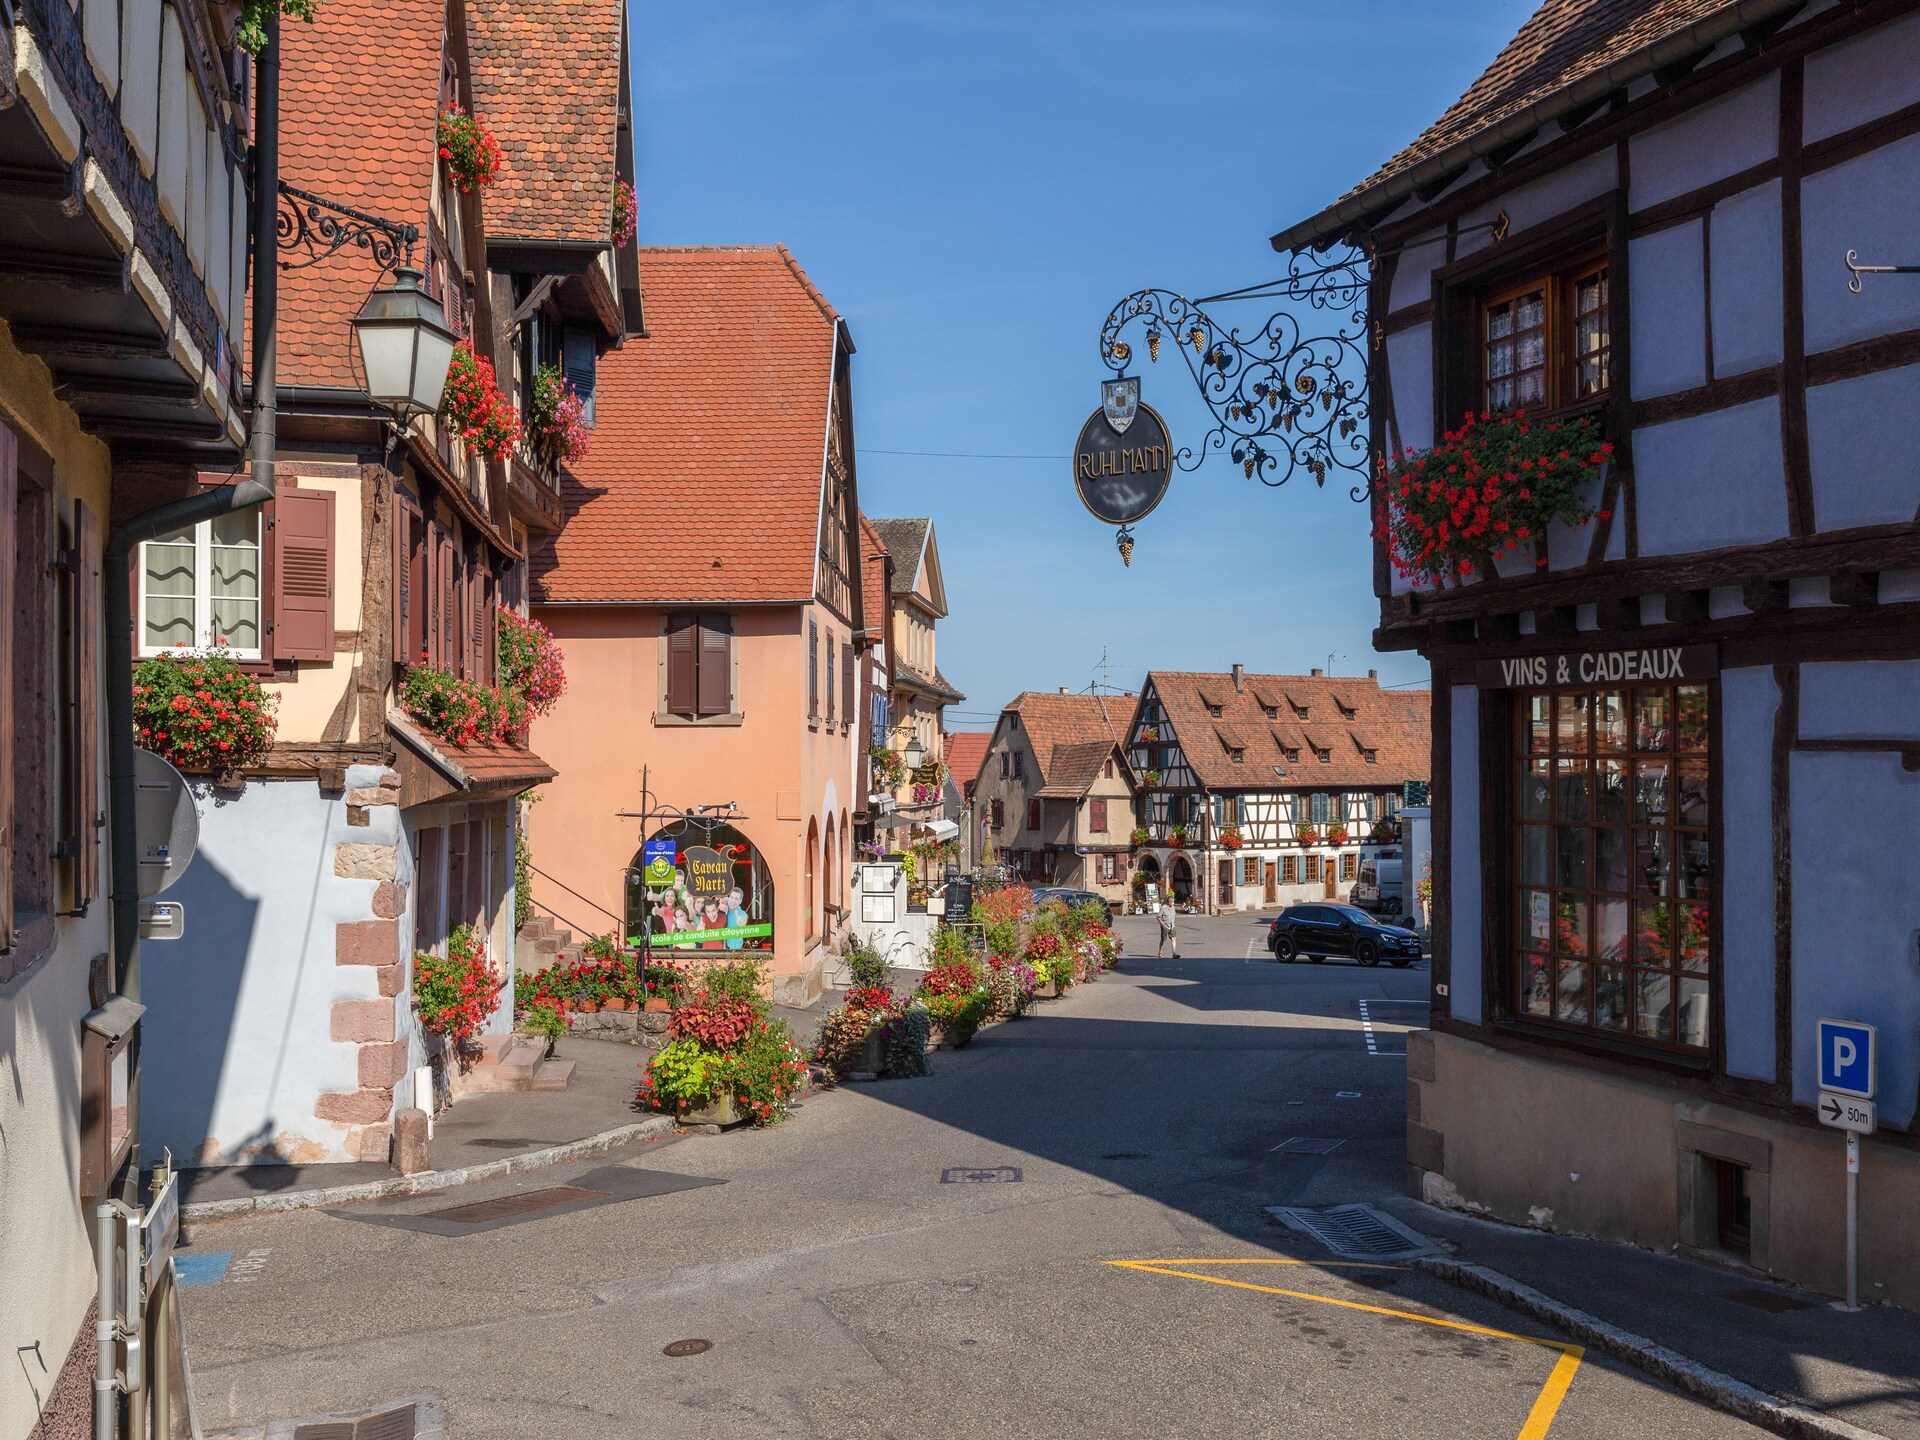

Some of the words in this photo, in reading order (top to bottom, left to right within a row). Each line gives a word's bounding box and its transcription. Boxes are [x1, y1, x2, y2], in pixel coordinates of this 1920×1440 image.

[1079, 445, 1166, 479] RUHLMANN
[1500, 656, 1547, 686] VINS
[1556, 655, 1570, 683] &
[1579, 648, 1684, 683] CADEAUX
[693, 860, 727, 874] Caveau
[695, 876, 726, 893] Nartz
[673, 932, 684, 941] de
[685, 930, 720, 940] conduite
[721, 926, 760, 938] citoyenne
[1834, 1035, 1857, 1078] P
[1848, 1107, 1868, 1125] 50m
